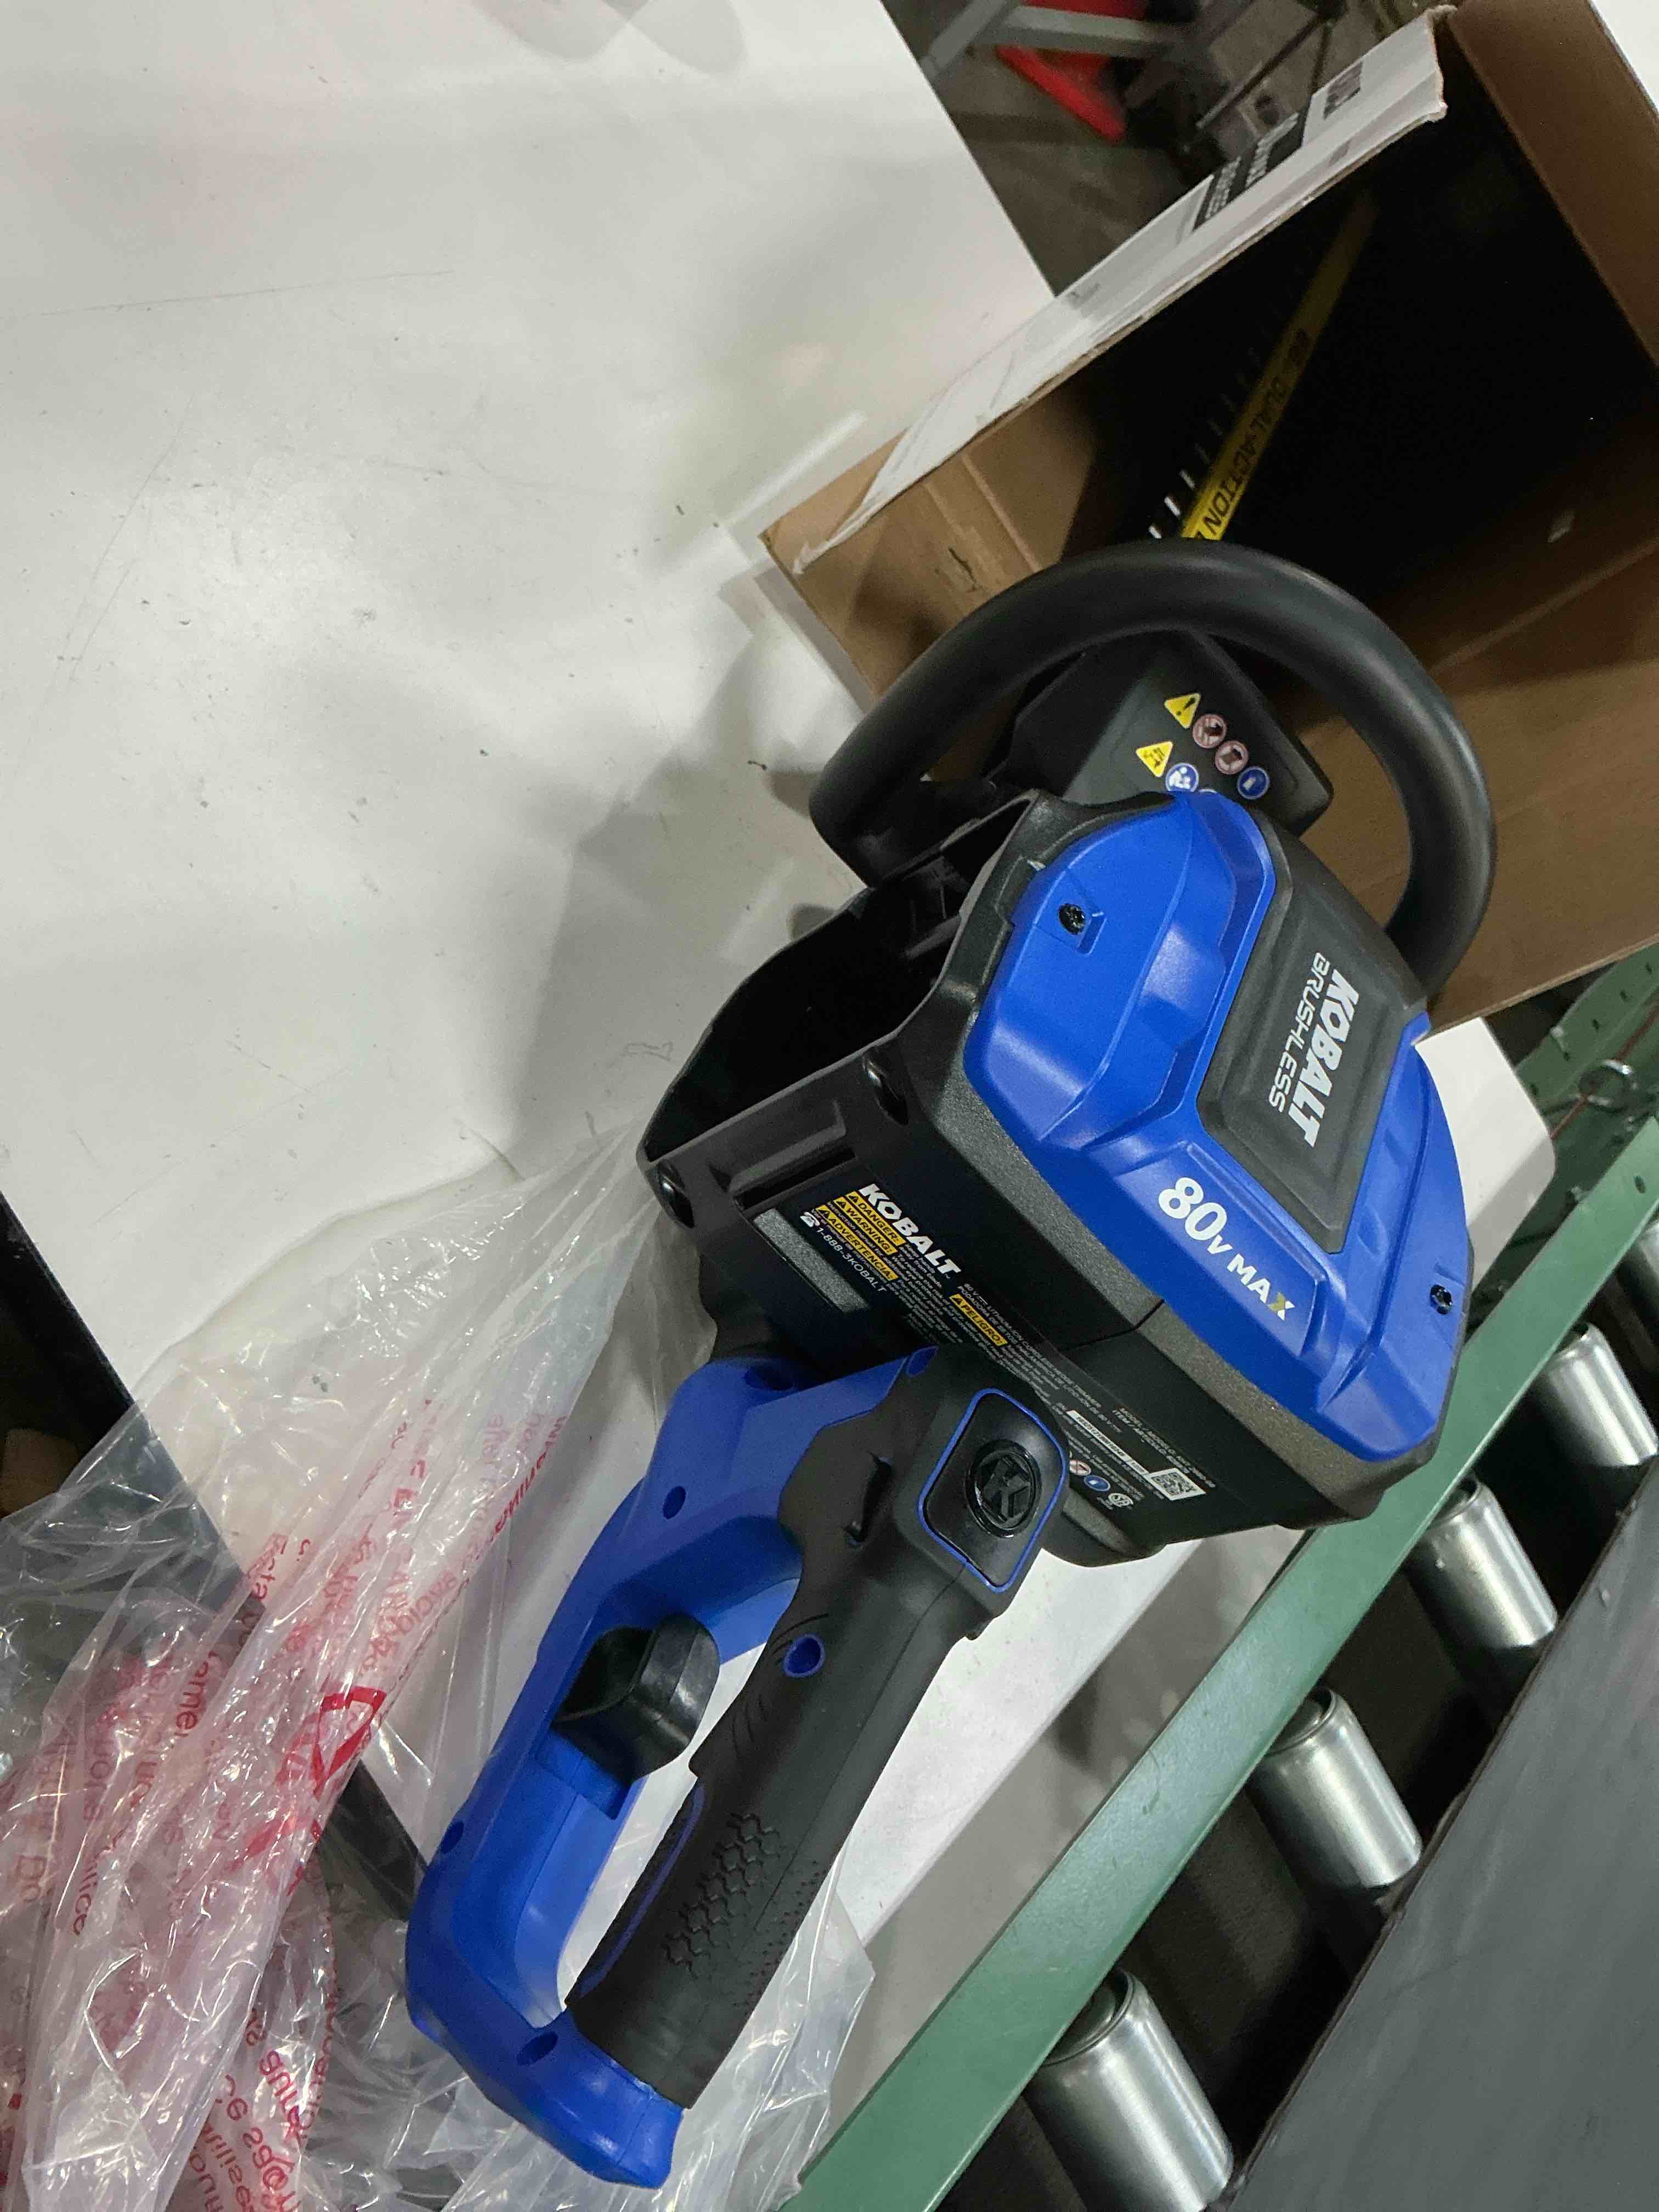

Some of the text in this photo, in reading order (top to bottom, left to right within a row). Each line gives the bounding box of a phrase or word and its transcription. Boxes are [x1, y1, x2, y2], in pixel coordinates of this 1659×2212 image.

[1202, 439, 1259, 535] ACTION
[1268, 952, 1330, 1113] BRUSHLESS
[1289, 969, 1359, 1148] KOBALT
[827, 1216, 895, 1280] ADVERTENCIA:
[843, 1207, 895, 1254] WARNING:
[856, 1202, 903, 1243] DANGER:
[858, 1183, 961, 1274] KOBALT
[816, 1227, 887, 1292] 1-888-3KOBALT
[1227, 1254, 1295, 1321] MAX
[960, 1304, 1004, 1345] PELIGRO:
